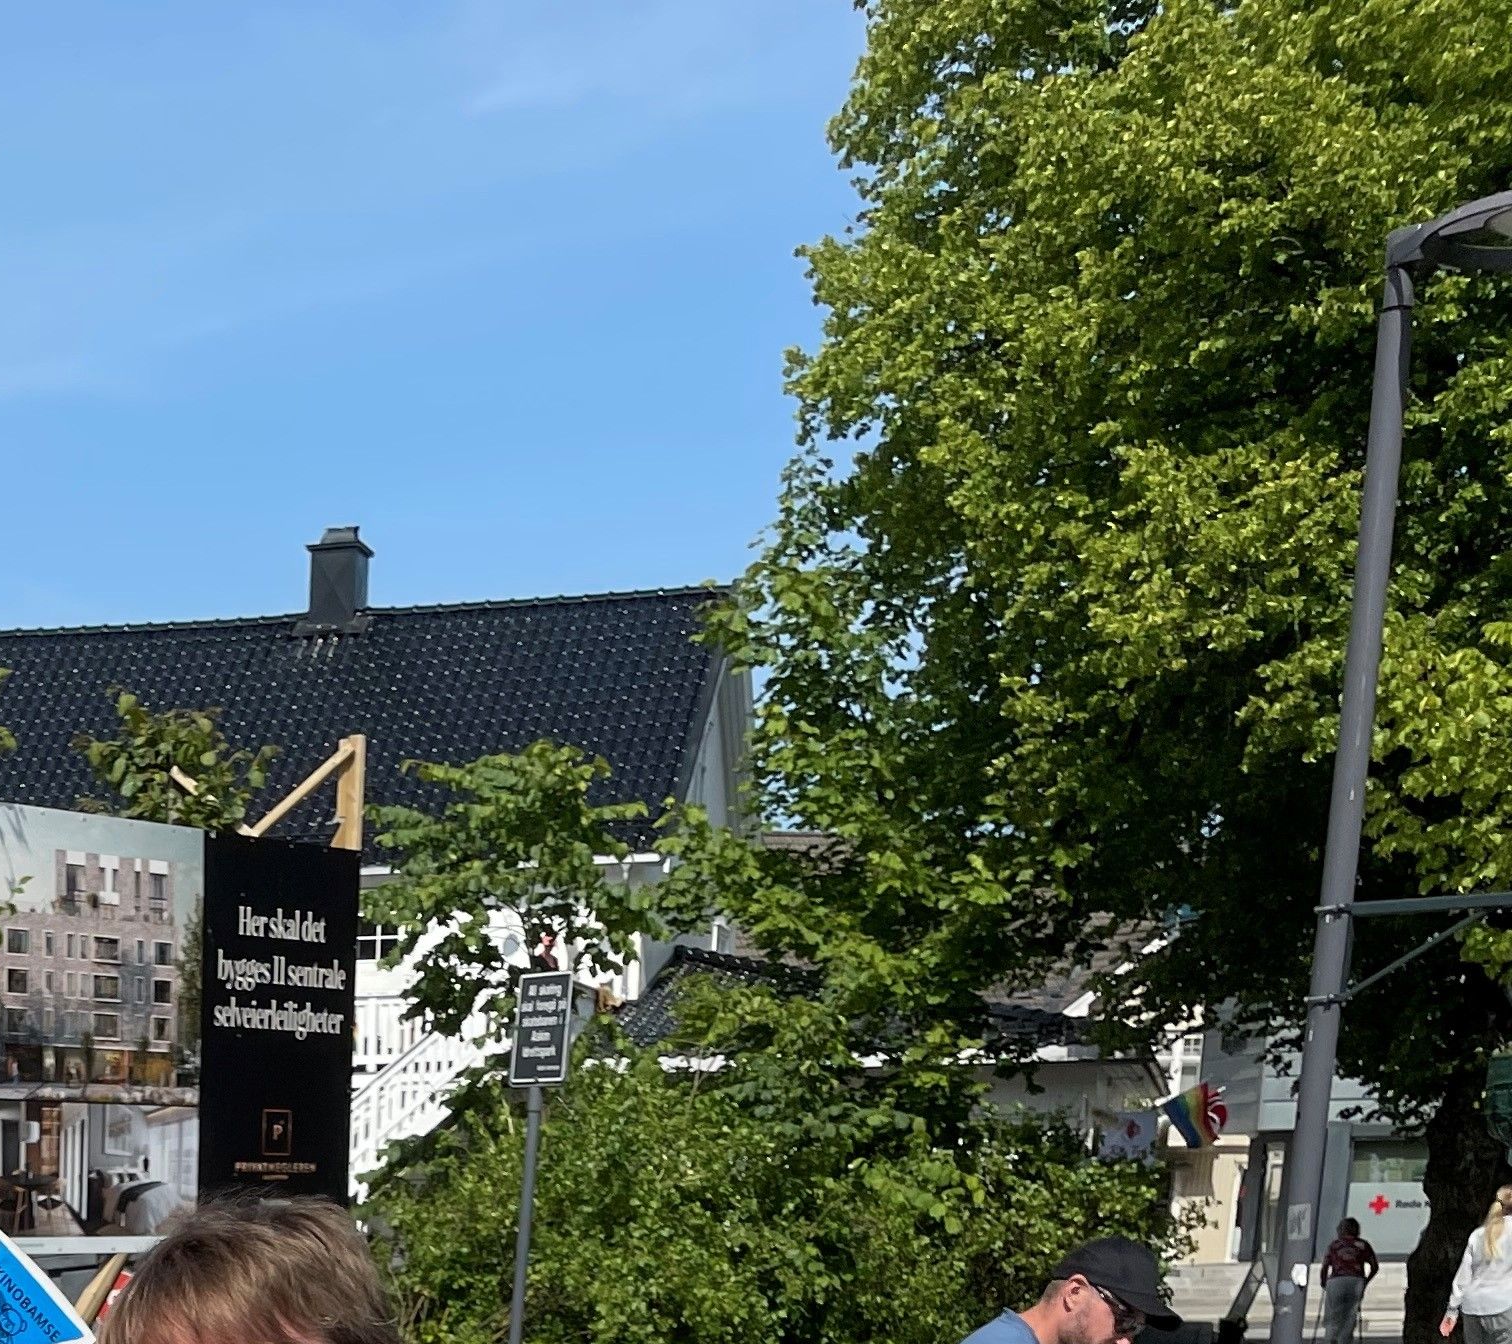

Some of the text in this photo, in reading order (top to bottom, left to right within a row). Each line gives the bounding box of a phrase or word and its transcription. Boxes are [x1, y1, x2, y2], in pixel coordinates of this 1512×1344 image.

[238, 905, 326, 943] Her skal det
[217, 948, 271, 991] bygges
[287, 958, 346, 990] sentrale
[213, 996, 345, 1040] selveierleiligheter
